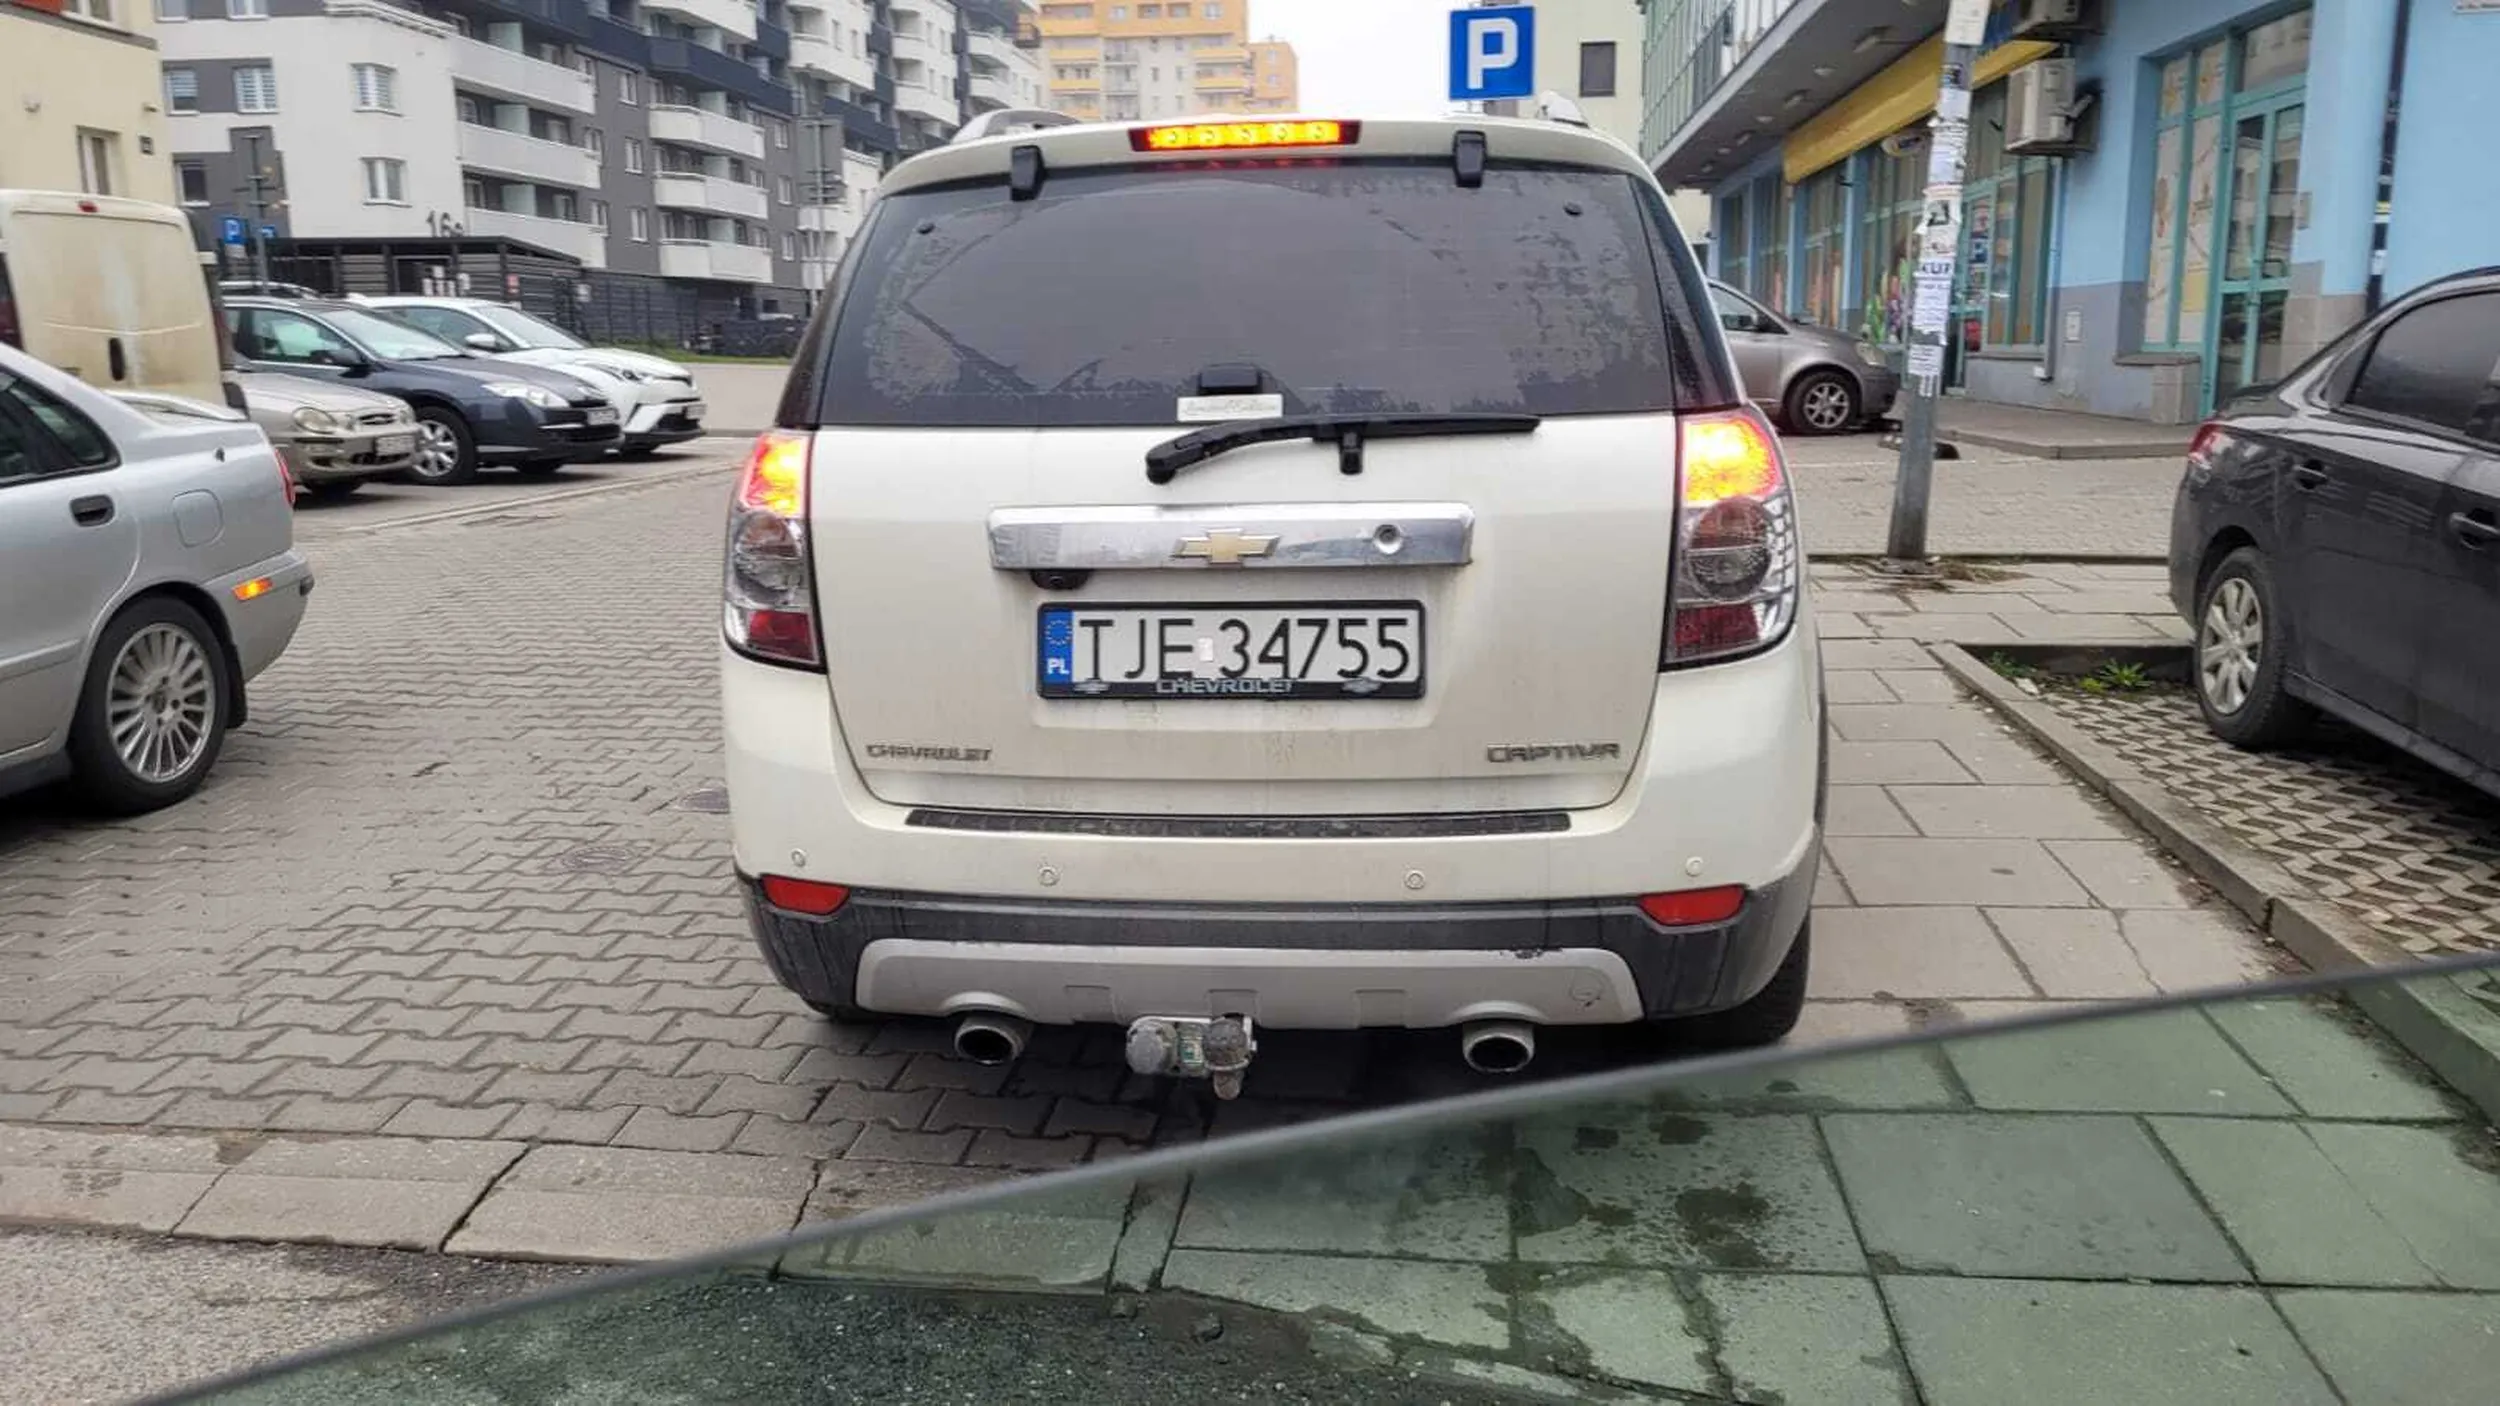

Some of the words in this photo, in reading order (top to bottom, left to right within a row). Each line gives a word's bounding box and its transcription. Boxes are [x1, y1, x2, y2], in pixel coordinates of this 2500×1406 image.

[1467, 17, 1518, 89] P
[1079, 618, 1194, 680] TJE
[1219, 617, 1410, 680] 34755
[1047, 658, 1069, 676] PL
[1157, 678, 1295, 694] CHEVROLET
[866, 744, 992, 762] CHEVROLET
[1487, 743, 1620, 763] CAPTIVA
